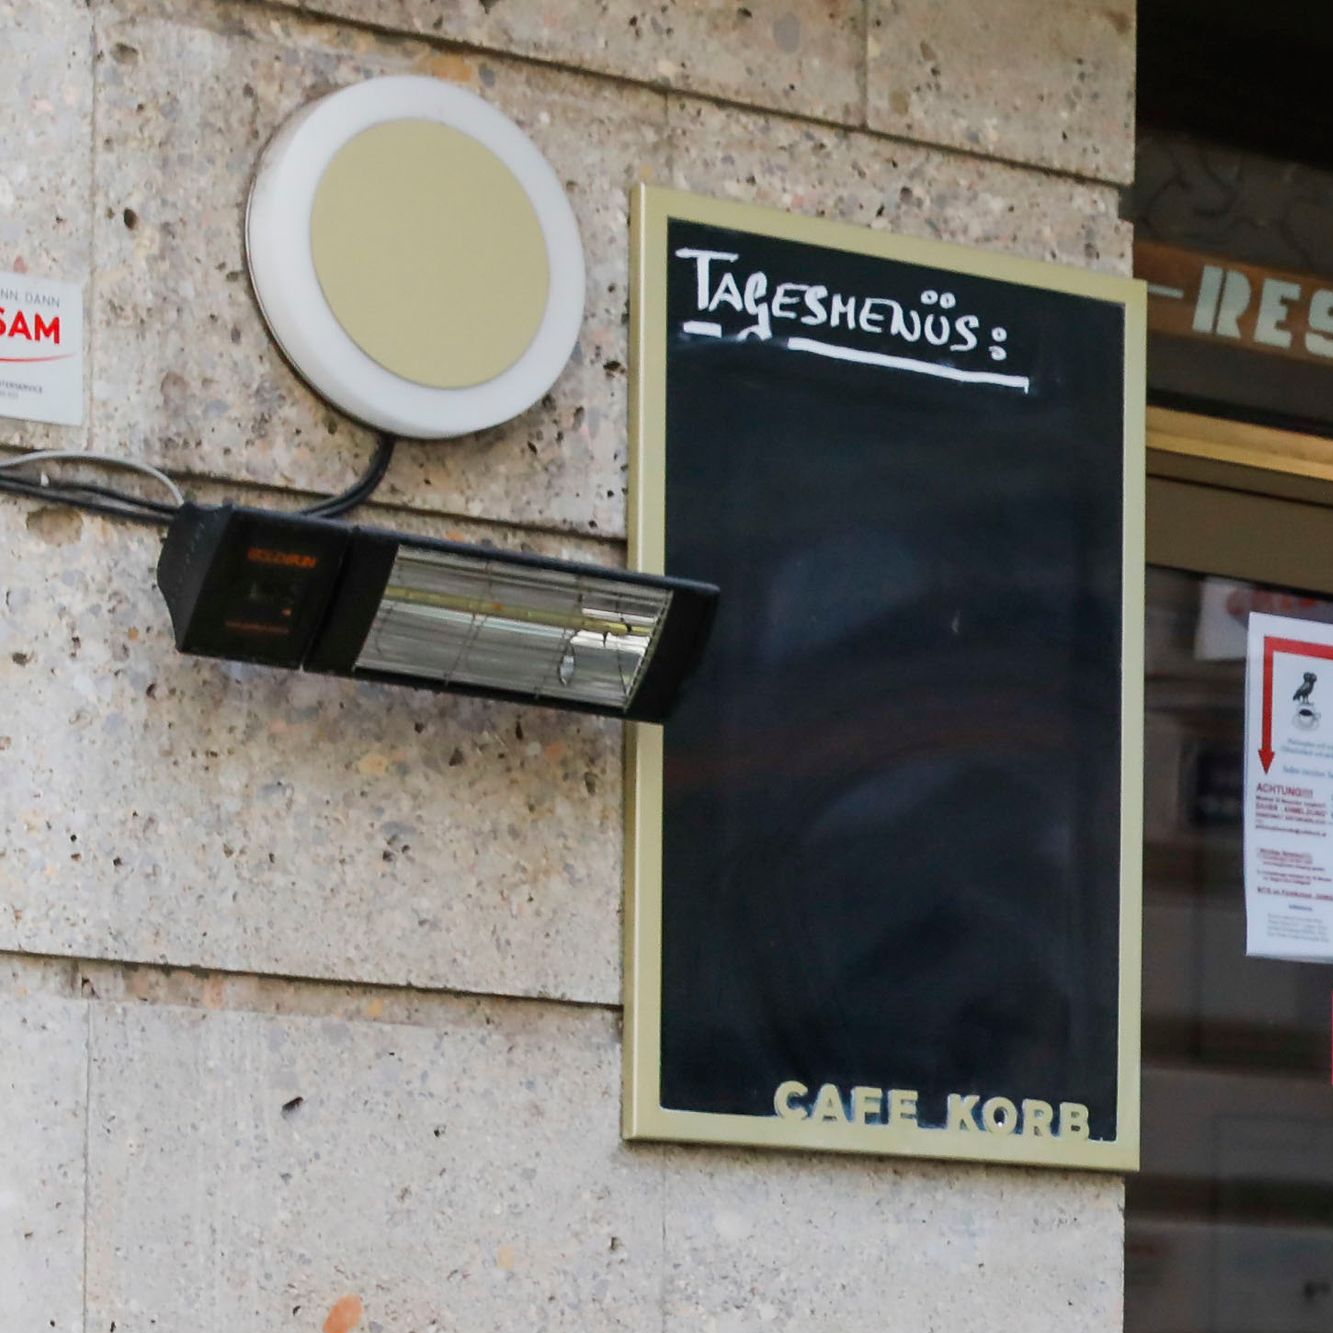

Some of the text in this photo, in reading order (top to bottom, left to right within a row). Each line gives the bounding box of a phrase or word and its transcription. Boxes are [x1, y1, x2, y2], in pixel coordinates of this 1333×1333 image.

[24, 290, 60, 308] DANN
[773, 1080, 1090, 1142] CAFE KORB
